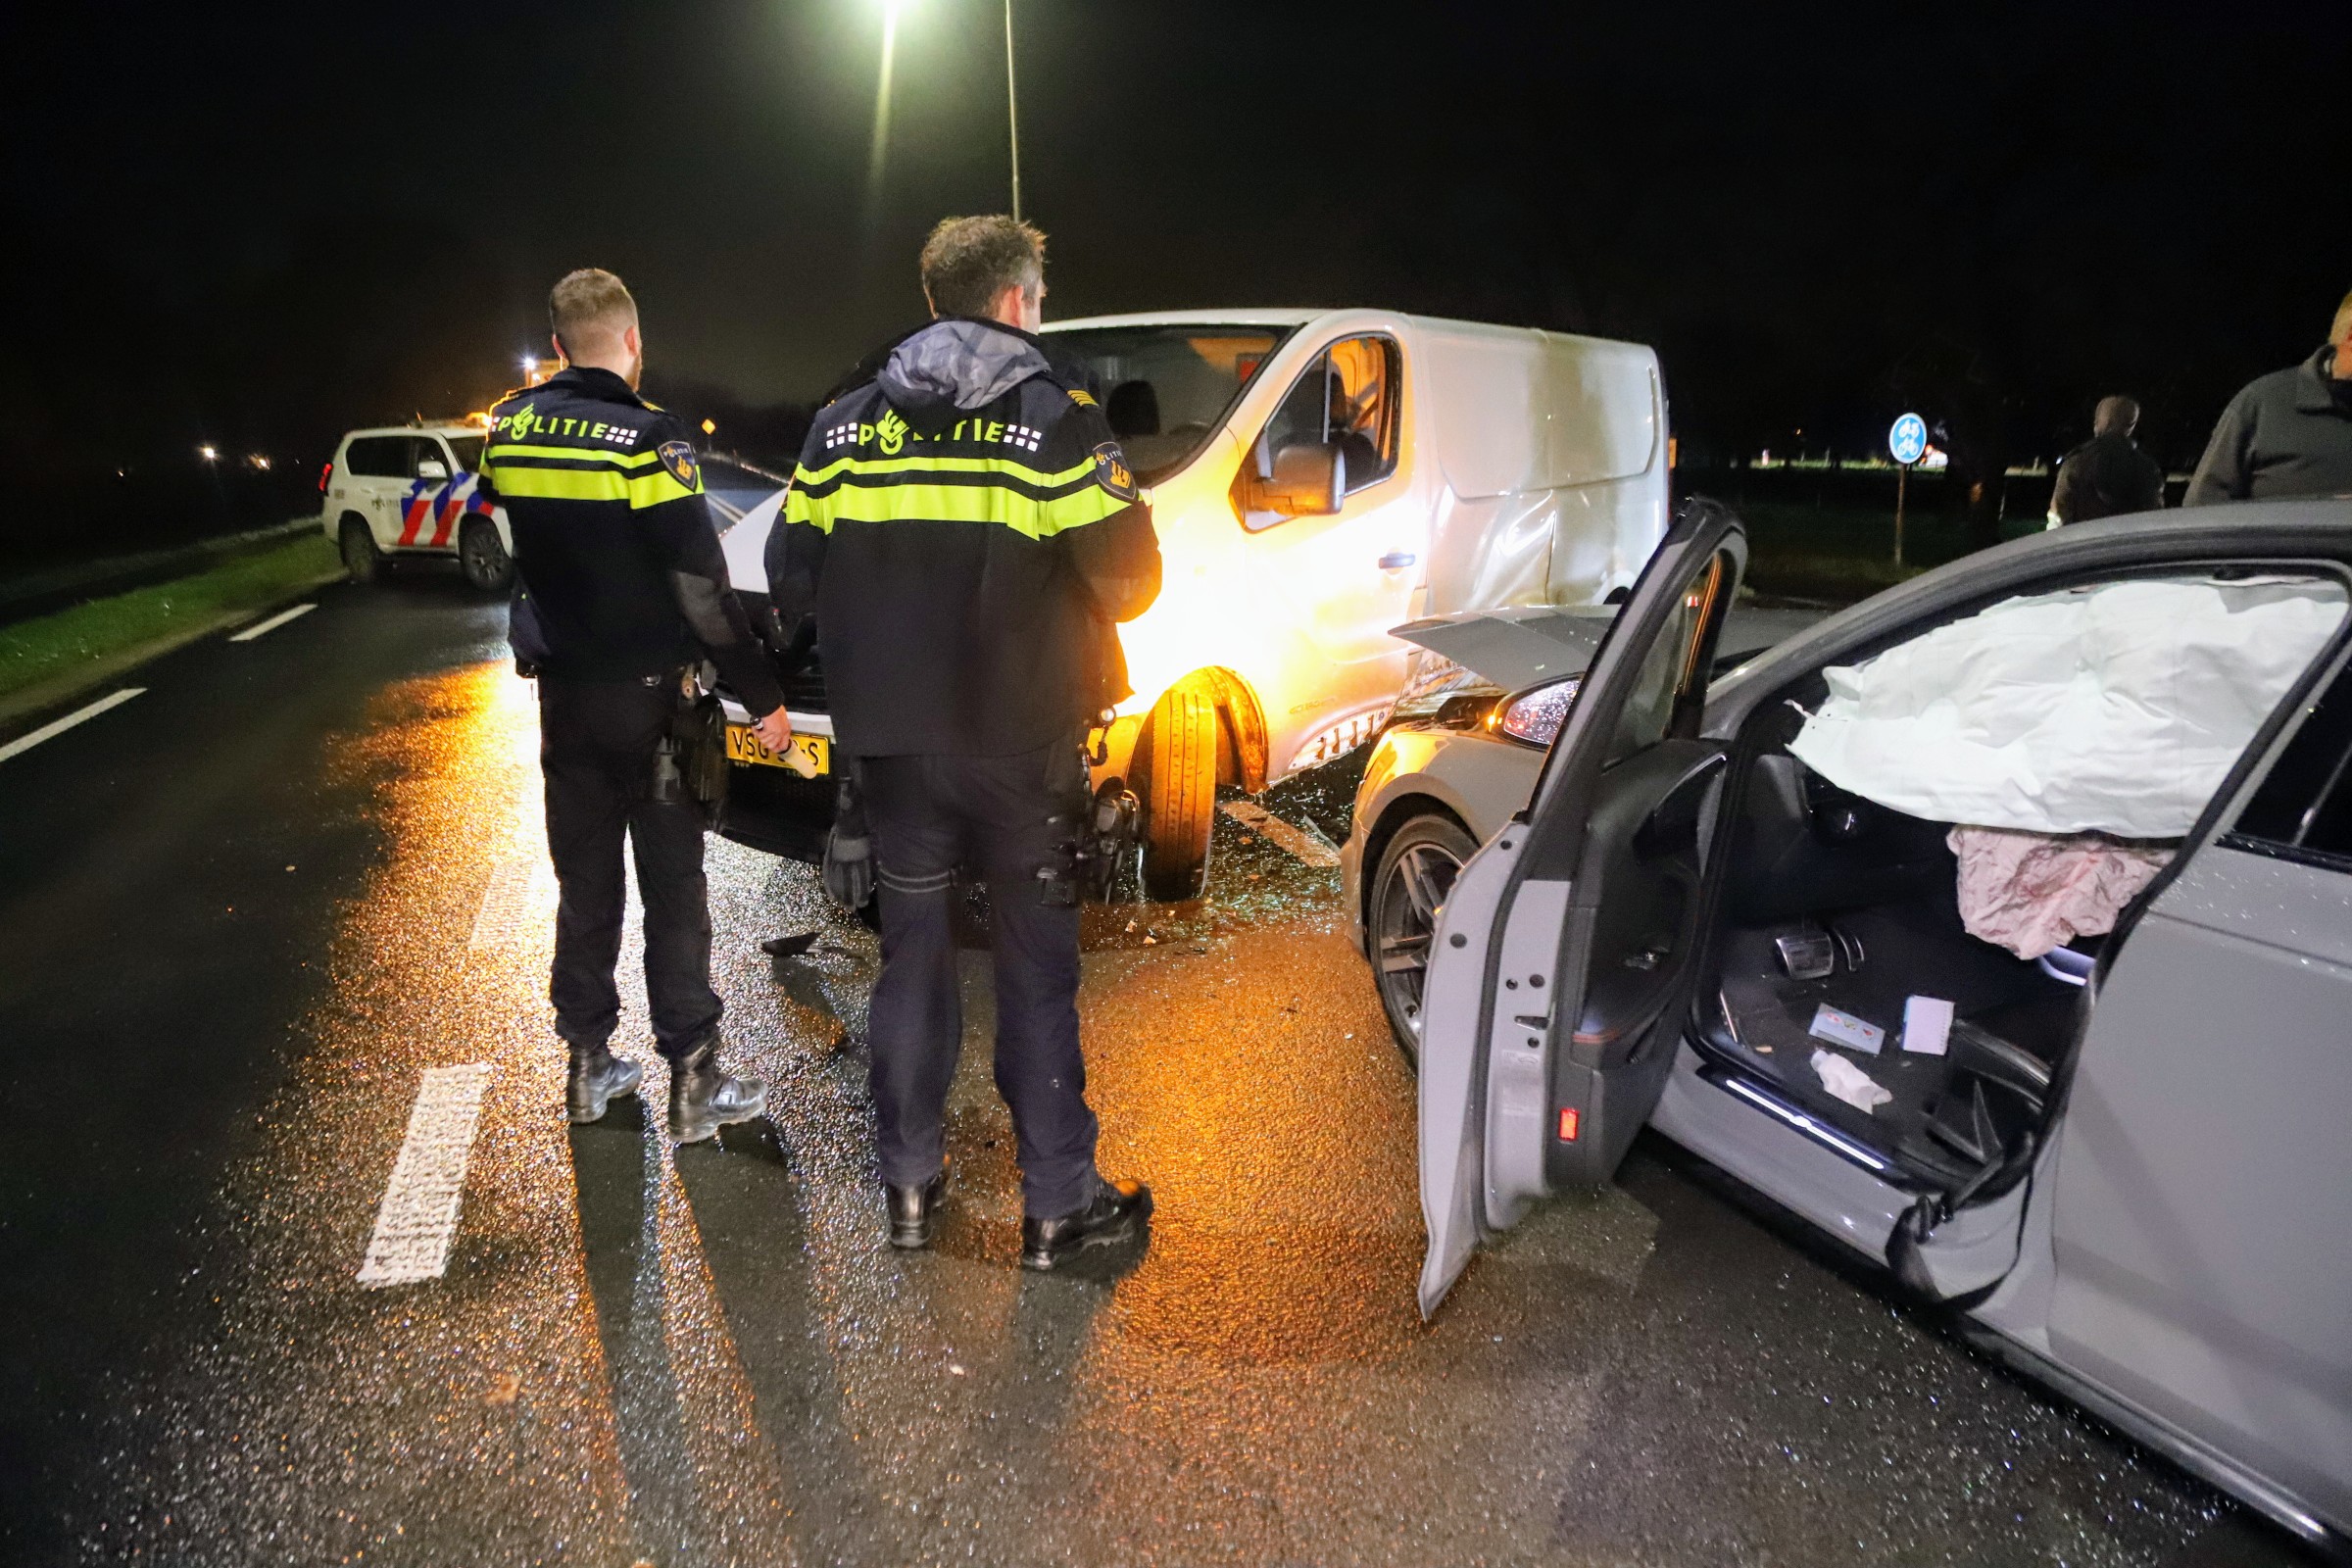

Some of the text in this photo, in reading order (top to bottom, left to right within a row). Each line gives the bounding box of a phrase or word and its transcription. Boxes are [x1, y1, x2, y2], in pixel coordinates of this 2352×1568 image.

[497, 403, 610, 441] POLITIE
[858, 409, 1004, 455] POTIE
[1095, 450, 1122, 466] OLITIE
